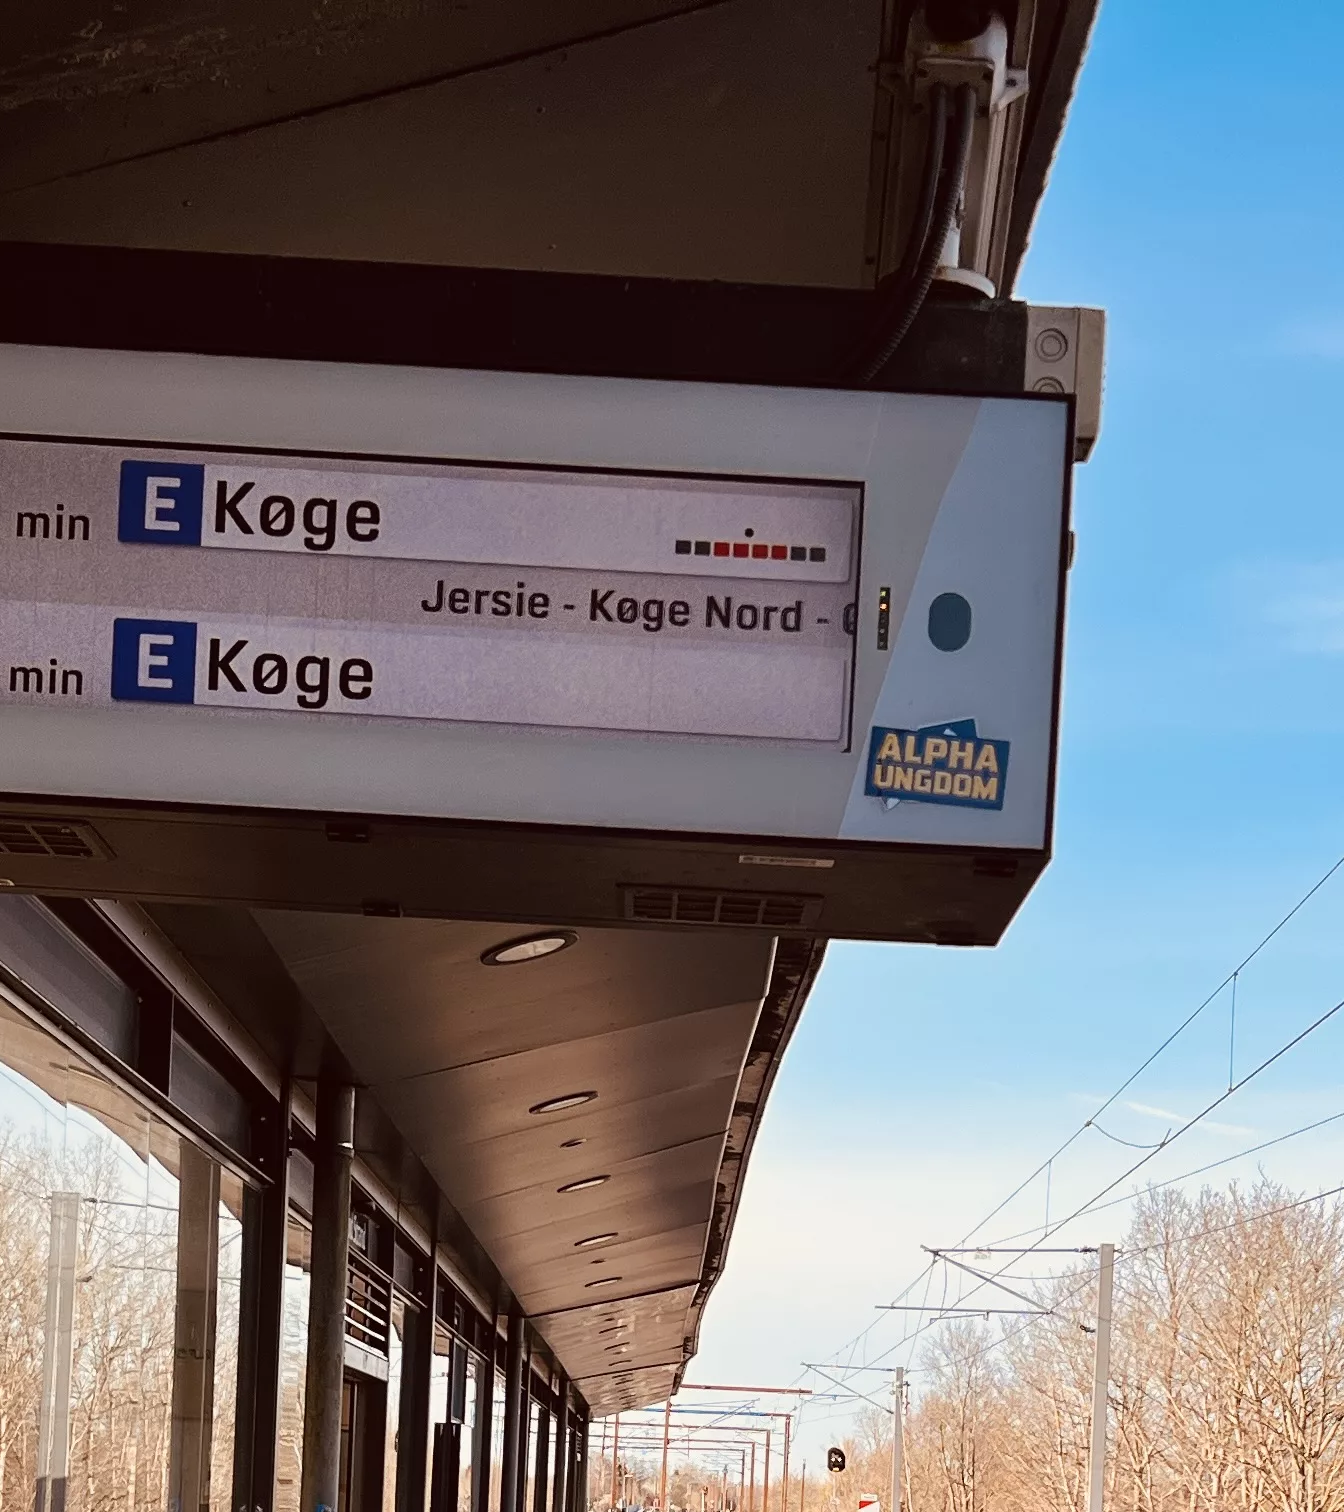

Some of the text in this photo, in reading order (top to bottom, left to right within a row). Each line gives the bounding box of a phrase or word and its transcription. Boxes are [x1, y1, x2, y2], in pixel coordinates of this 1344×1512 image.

[16, 504, 91, 541] min
[144, 476, 181, 532] E
[214, 480, 381, 551] Køge
[421, 580, 550, 619] Jersie
[589, 587, 691, 633] Køge
[705, 595, 803, 632] Nord
[9, 658, 84, 695] min
[137, 632, 174, 688] E
[207, 638, 374, 709] Køge
[876, 733, 999, 773] ALPHA
[873, 764, 998, 801] UNGDOM
